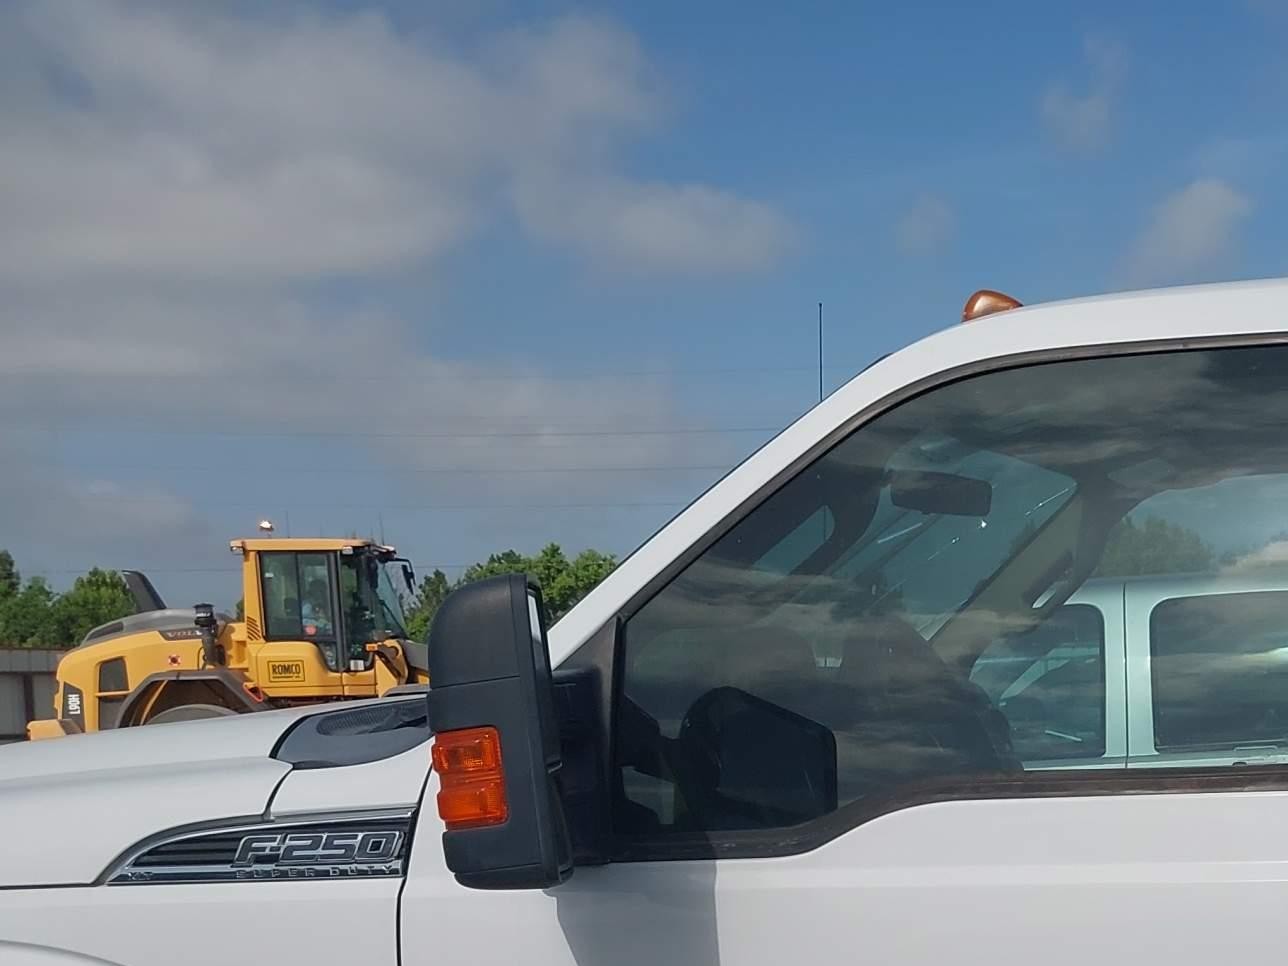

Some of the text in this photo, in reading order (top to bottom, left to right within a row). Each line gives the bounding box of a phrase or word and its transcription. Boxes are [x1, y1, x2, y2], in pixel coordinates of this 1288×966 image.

[272, 664, 301, 675] ROMCO
[68, 694, 81, 715] L90H
[236, 864, 393, 879] SUPER DUTY
